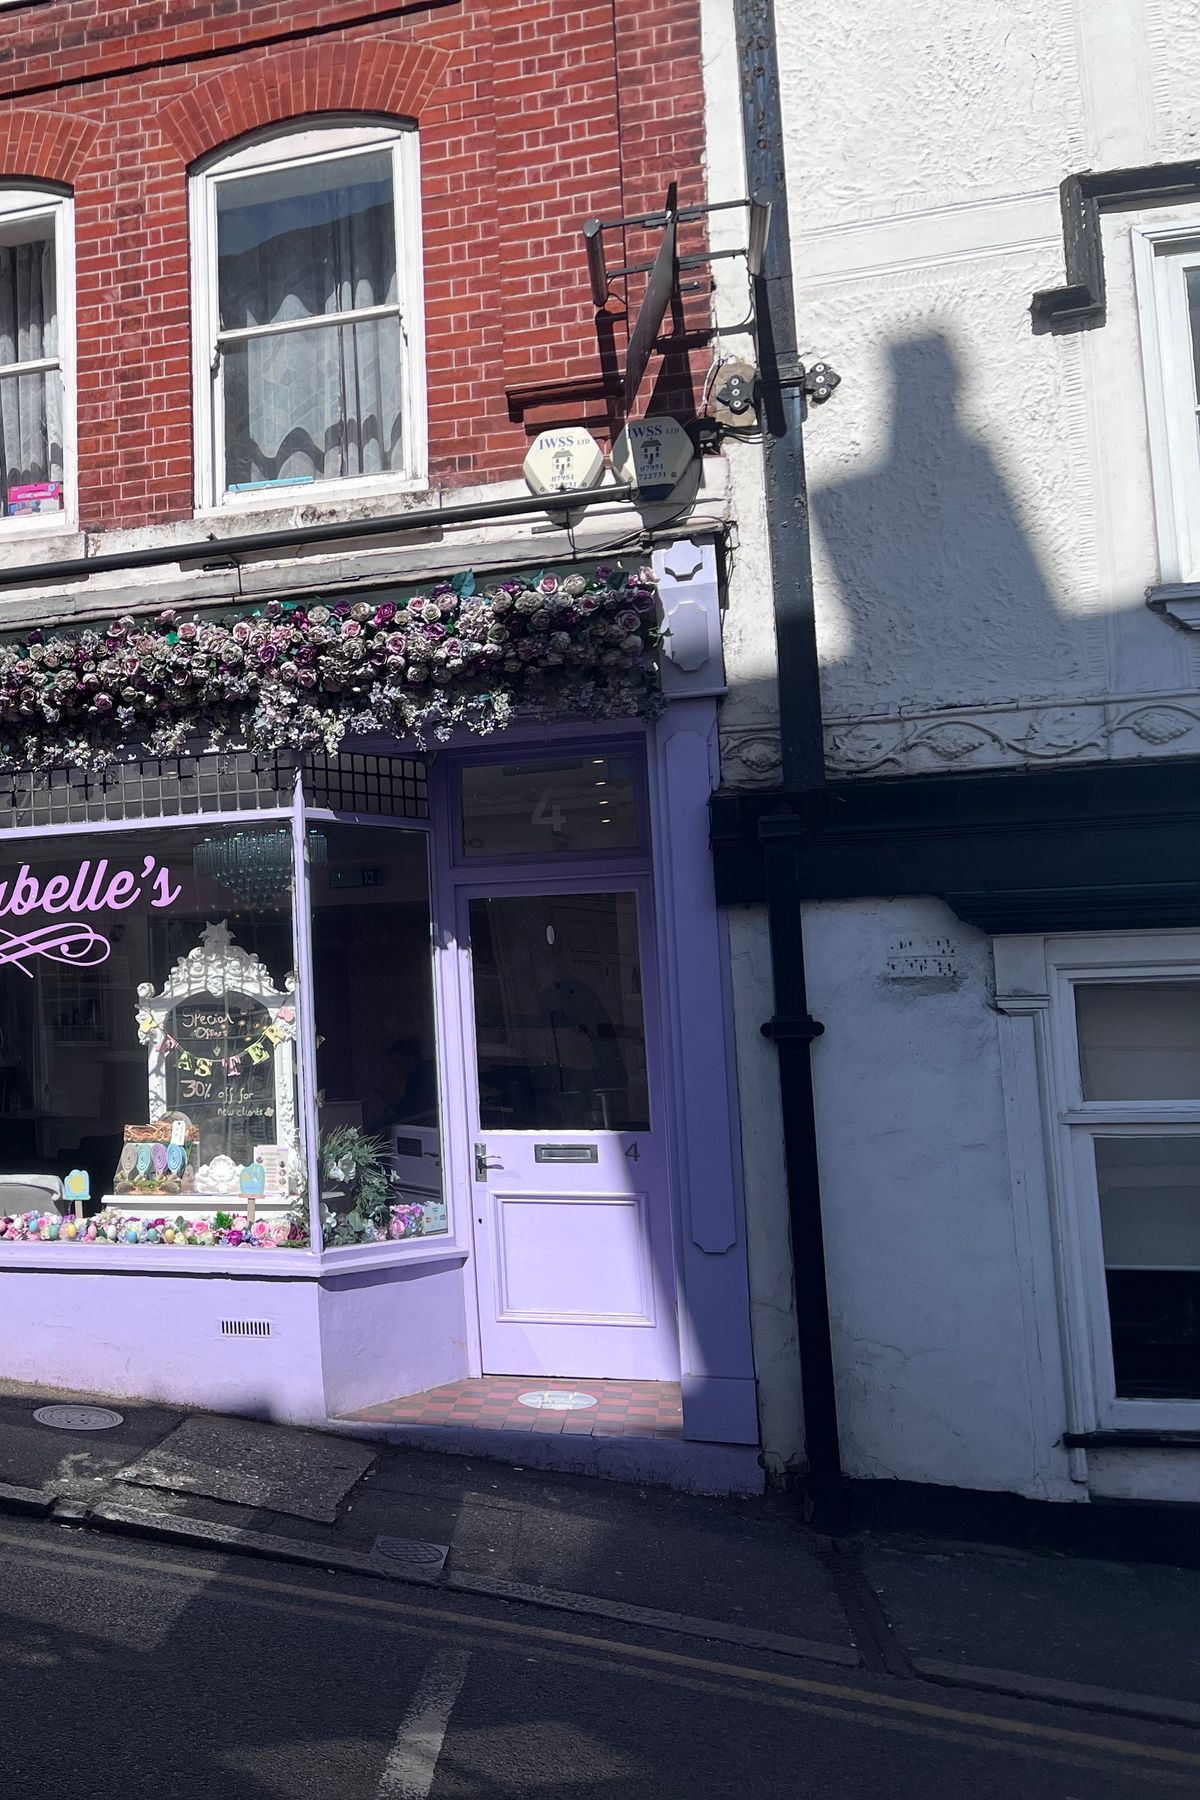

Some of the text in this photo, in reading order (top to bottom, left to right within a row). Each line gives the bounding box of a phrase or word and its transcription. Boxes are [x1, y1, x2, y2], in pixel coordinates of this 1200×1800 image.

[628, 424, 662, 440] IWSS
[539, 435, 590, 450] IWSS LTD
[640, 463, 664, 472] 07951
[551, 473, 574, 482] 07951
[638, 471, 666, 480] 722731
[531, 782, 567, 832] 4
[182, 1008, 234, 1027] Special
[180, 1079, 254, 1104] 30% off for
[217, 1107, 235, 1117] new
[624, 1141, 640, 1162] 4
